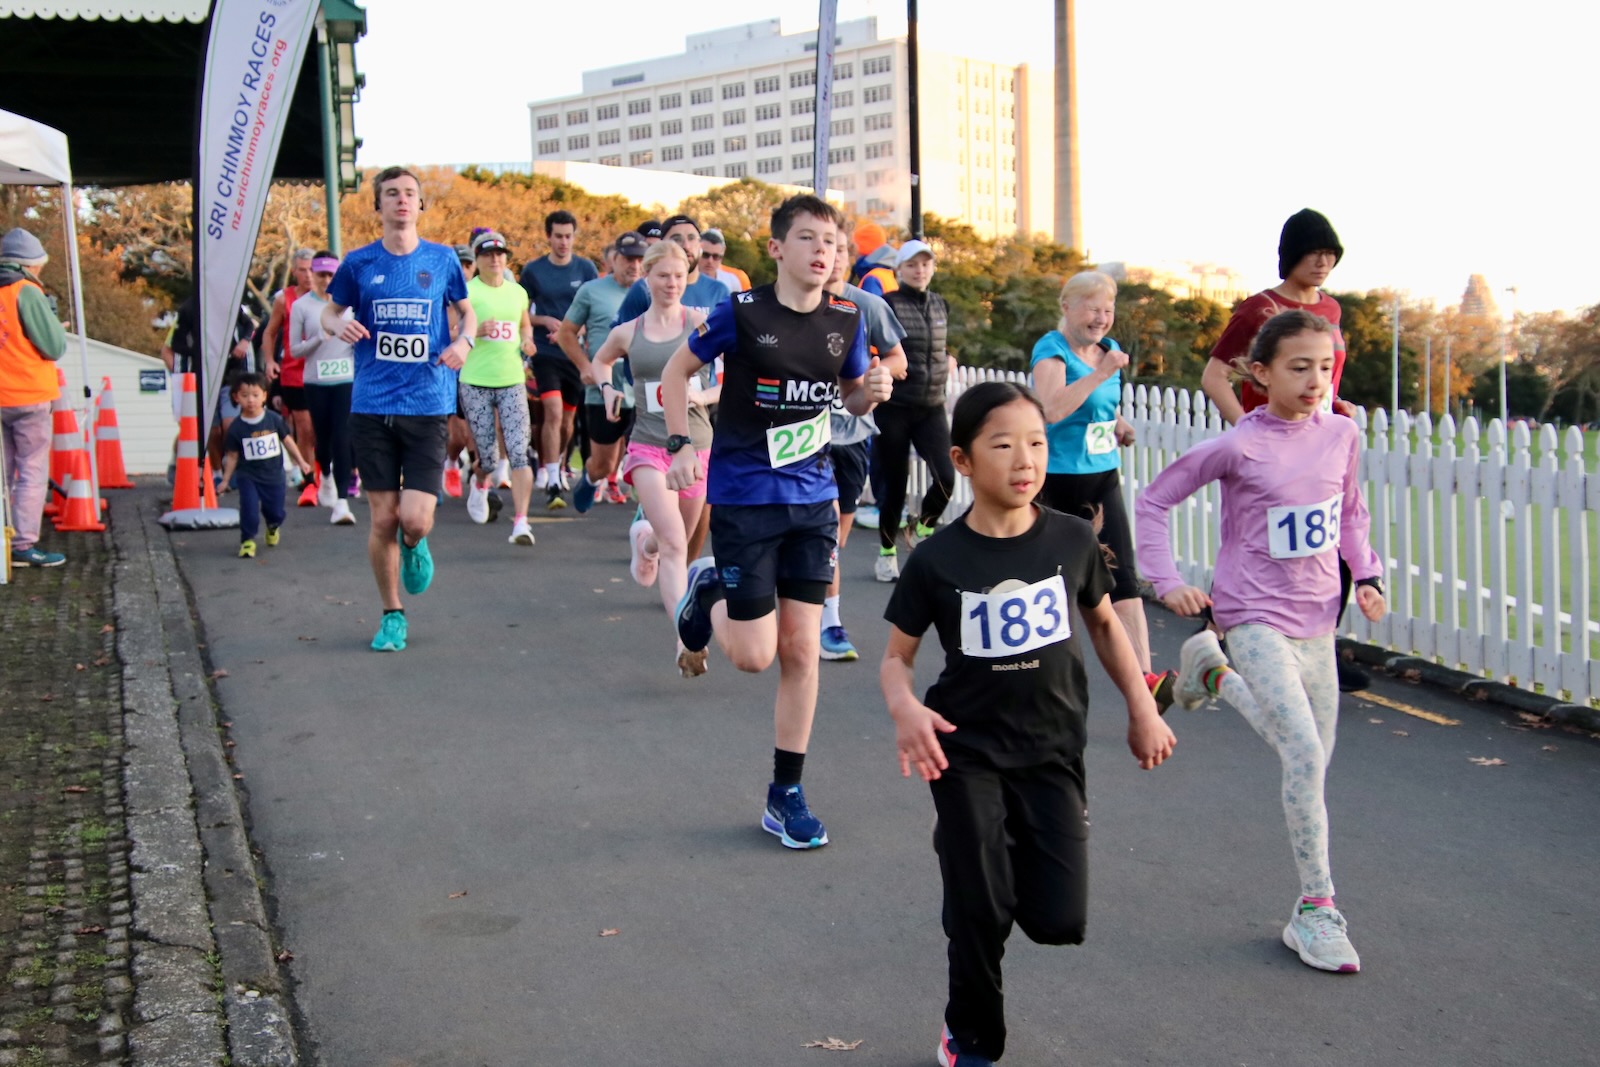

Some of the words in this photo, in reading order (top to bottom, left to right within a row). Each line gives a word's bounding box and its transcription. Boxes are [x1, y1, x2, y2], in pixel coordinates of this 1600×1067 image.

[242, 11, 276, 91] RACES
[217, 93, 252, 198] CHINMOY
[231, 39, 287, 231] nz.srichinmoyraces.org
[207, 201, 228, 240] SRI
[377, 303, 427, 320] REBEL
[320, 360, 349, 376] 228
[379, 335, 425, 358] 660
[247, 436, 277, 457] 184
[773, 412, 828, 461] 227
[1278, 501, 1339, 551] 185
[970, 588, 1060, 649] 183
[992, 659, 1040, 671] mont-bell
